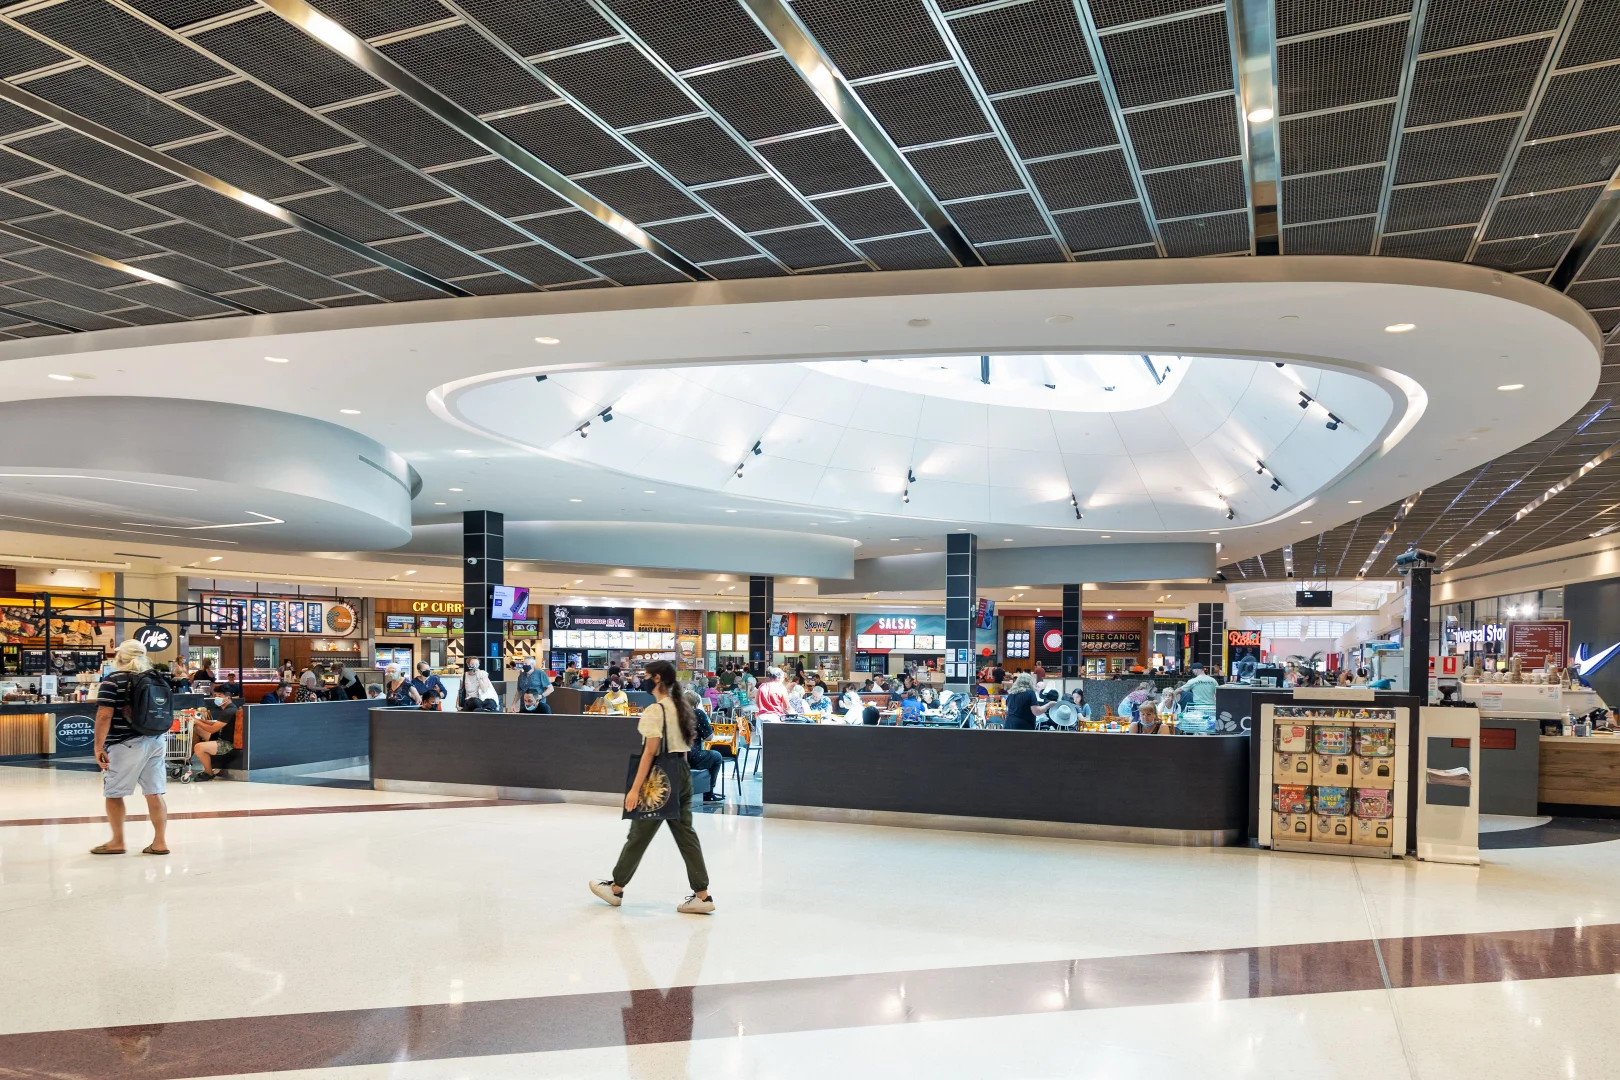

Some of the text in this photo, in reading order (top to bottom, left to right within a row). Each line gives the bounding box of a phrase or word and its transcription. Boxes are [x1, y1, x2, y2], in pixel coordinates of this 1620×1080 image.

[413, 602, 464, 613] CP CURR
[879, 617, 916, 630] SALSAS
[1107, 633, 1140, 641] CANTON
[1447, 625, 1486, 643] niversal
[1487, 623, 1507, 641] Stor
